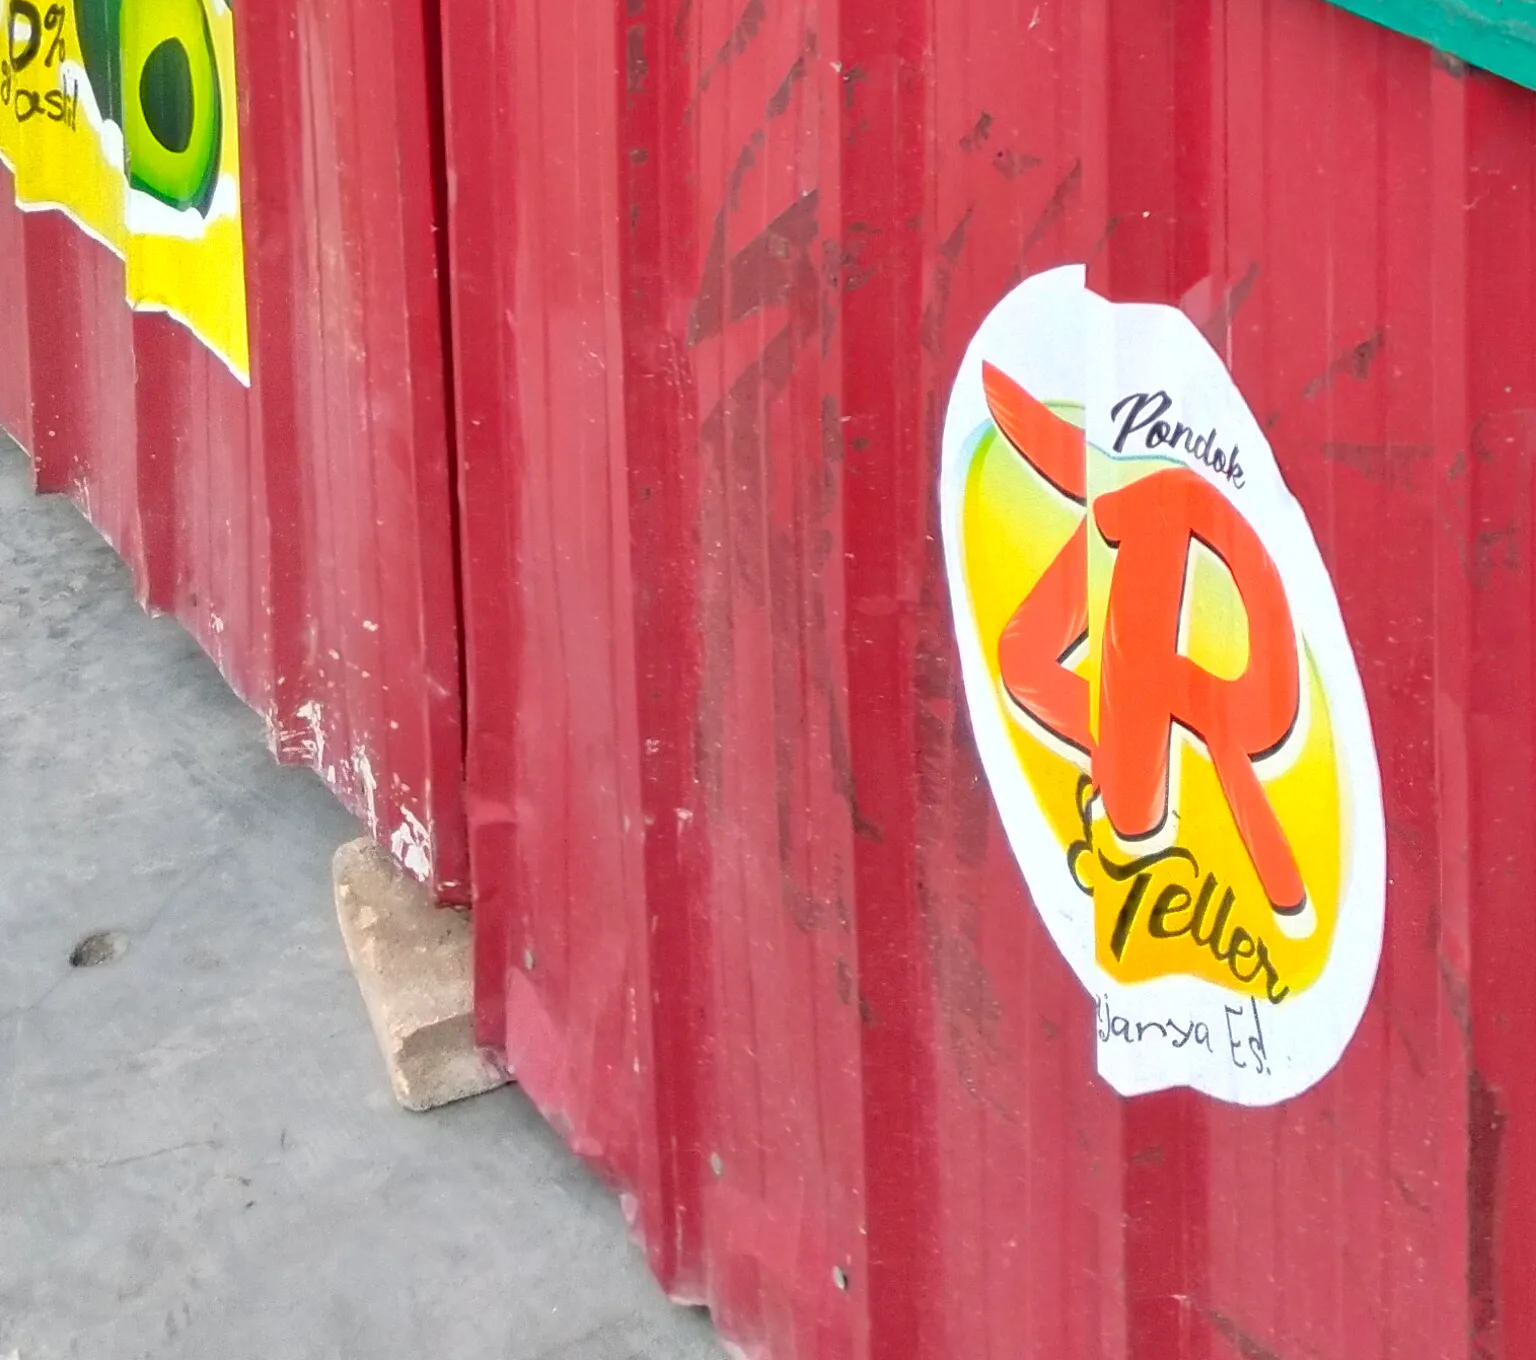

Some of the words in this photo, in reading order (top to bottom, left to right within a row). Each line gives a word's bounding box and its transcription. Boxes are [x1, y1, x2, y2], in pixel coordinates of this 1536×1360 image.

[1108, 390, 1246, 493] Pondok
[982, 359, 1309, 916] ZR
[1097, 845, 1290, 1005] Teller
